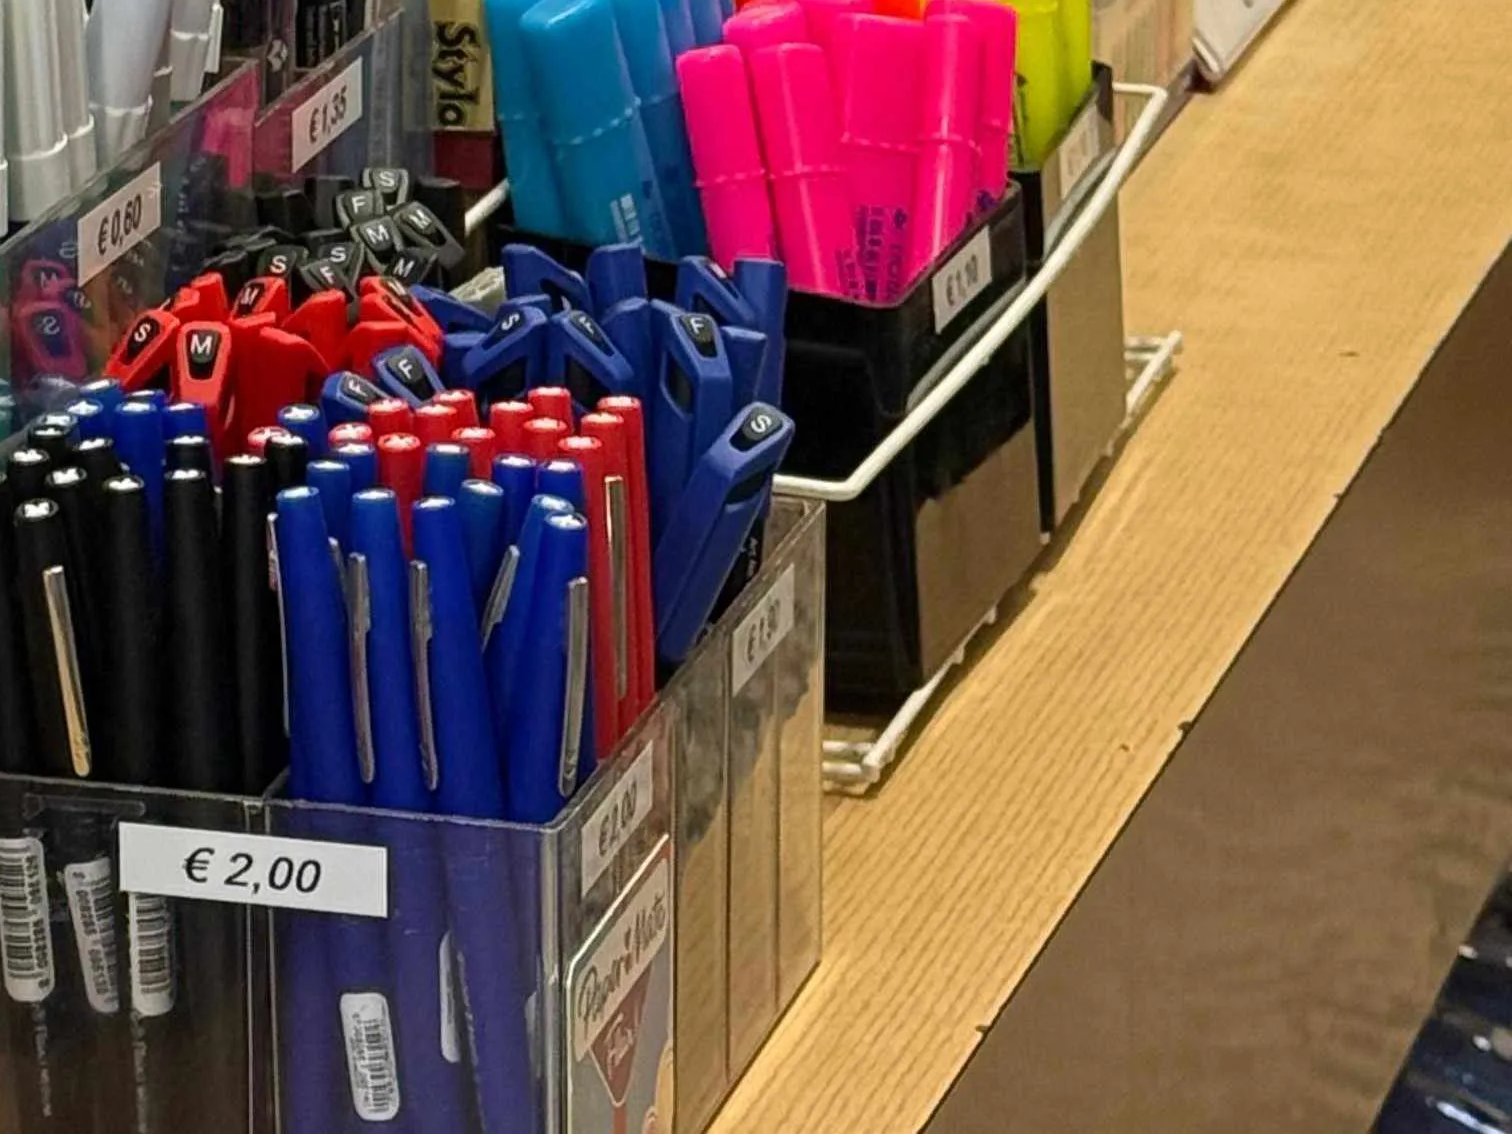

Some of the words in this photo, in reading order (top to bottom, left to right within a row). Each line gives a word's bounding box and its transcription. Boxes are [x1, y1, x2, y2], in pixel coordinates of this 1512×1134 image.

[433, 21, 482, 129] Stylo
[380, 171, 394, 187] S
[351, 196, 366, 214] F
[366, 225, 390, 245] M
[269, 254, 288, 274] S
[330, 247, 346, 263] S
[394, 257, 414, 278] M
[501, 312, 519, 331] S
[690, 318, 707, 335] F
[134, 323, 152, 342] S
[191, 334, 211, 355] M
[398, 359, 414, 380] F
[751, 413, 771, 434] S
[183, 847, 215, 885] €
[223, 850, 323, 896] 2,00
